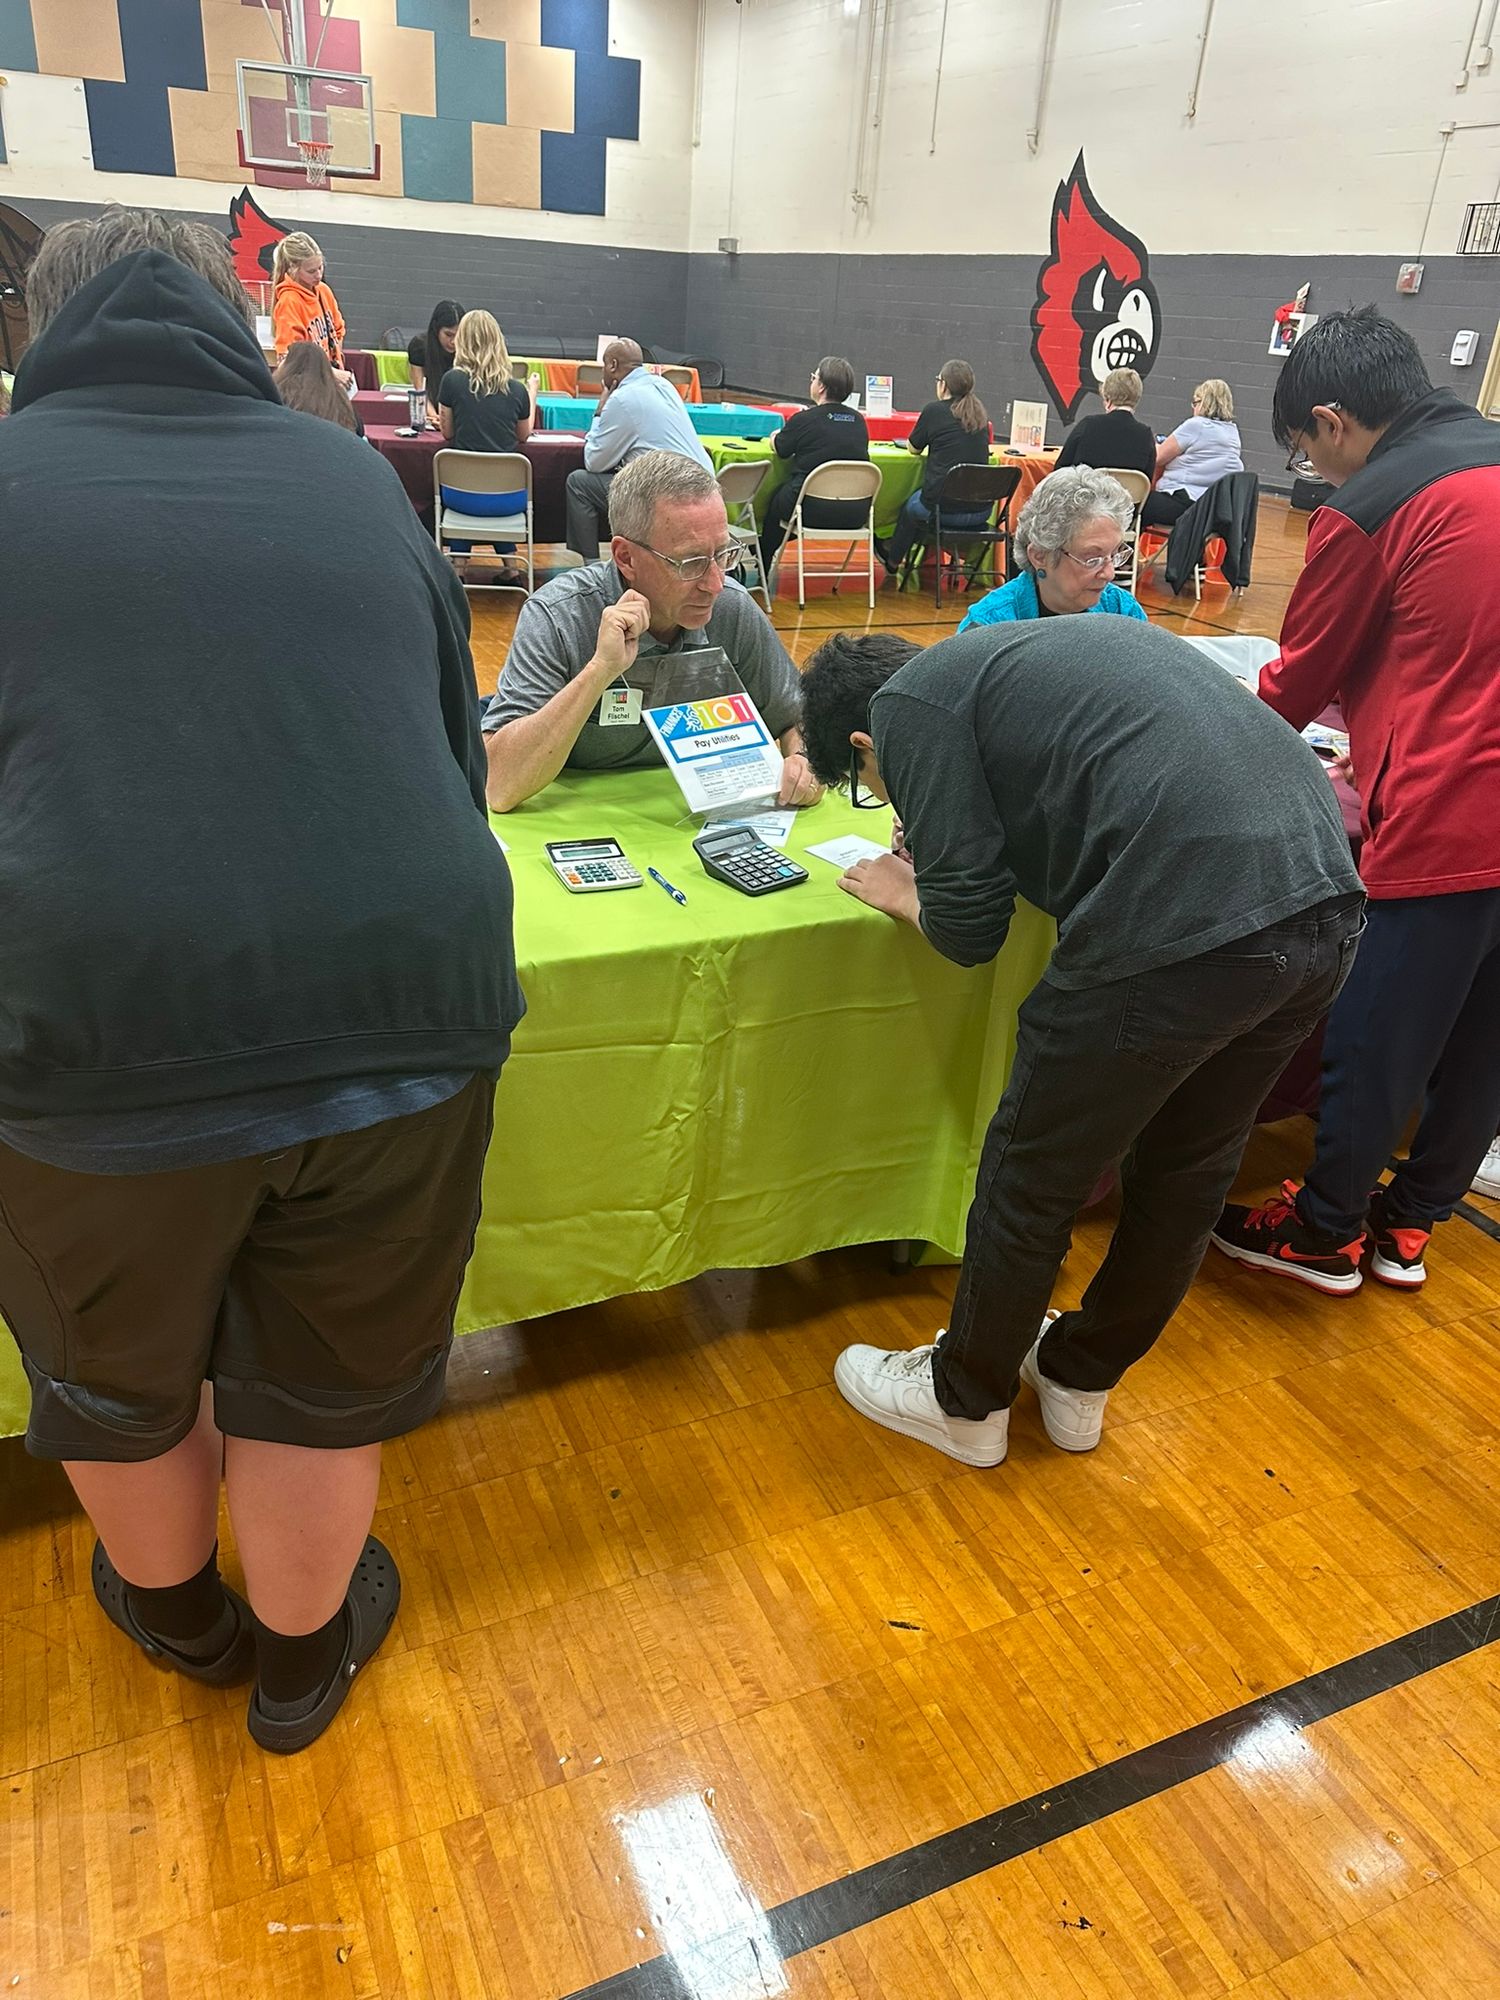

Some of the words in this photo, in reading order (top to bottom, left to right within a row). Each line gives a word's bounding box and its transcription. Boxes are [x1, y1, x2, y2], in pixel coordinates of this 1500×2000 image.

[697, 699, 751, 726] 101
[694, 739, 711, 748] Pay
[713, 733, 741, 745] Utilities
